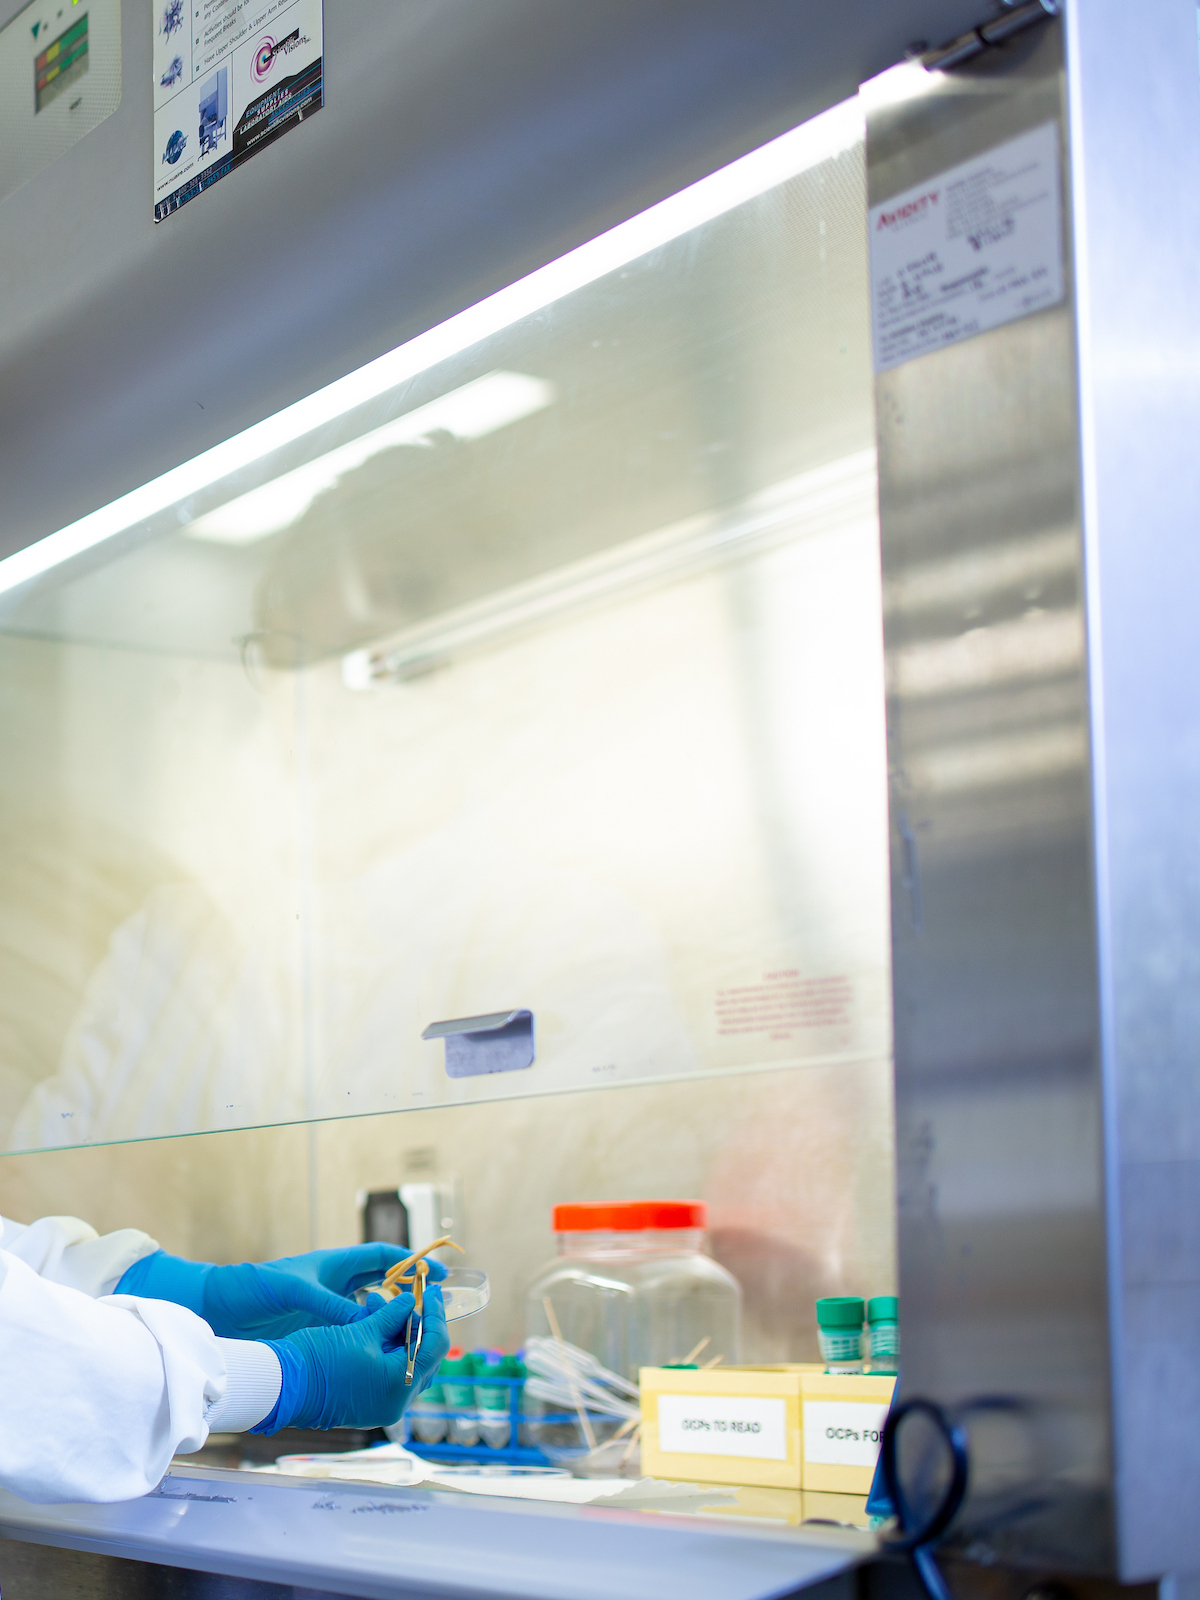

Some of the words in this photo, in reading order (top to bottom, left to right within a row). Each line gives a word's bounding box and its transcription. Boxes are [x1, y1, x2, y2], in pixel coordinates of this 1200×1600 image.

[223, 7, 237, 23] should
[204, 29, 222, 47] Frequent
[223, 18, 237, 32] Breaks
[204, 53, 215, 65] Have
[215, 43, 228, 56] Upper
[229, 28, 247, 46] Shoulder
[253, 13, 267, 26] Upper
[246, 87, 281, 118] EQUIPMENT
[257, 88, 289, 116] SUPPLIES
[730, 1421, 762, 1434] READ
[825, 1427, 860, 1441] OCPs
